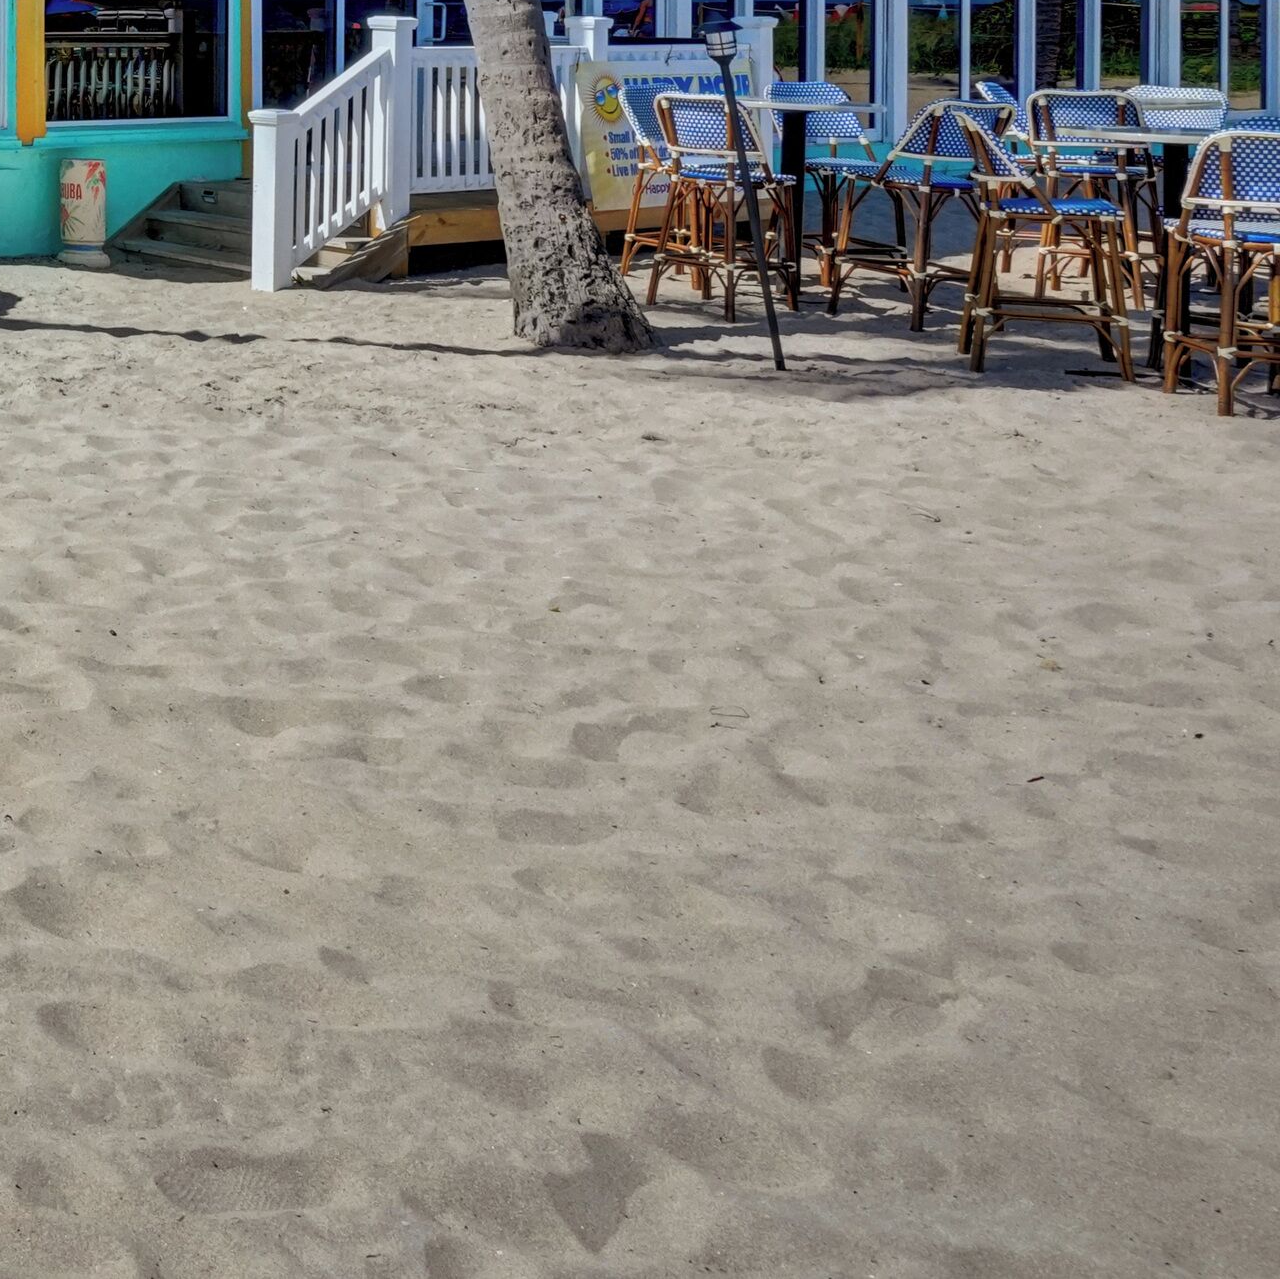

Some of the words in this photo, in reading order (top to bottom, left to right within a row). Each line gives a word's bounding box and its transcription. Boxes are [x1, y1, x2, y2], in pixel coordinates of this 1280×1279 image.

[608, 131, 630, 144] Small
[610, 147, 629, 161] 50%
[612, 164, 629, 177] Live
